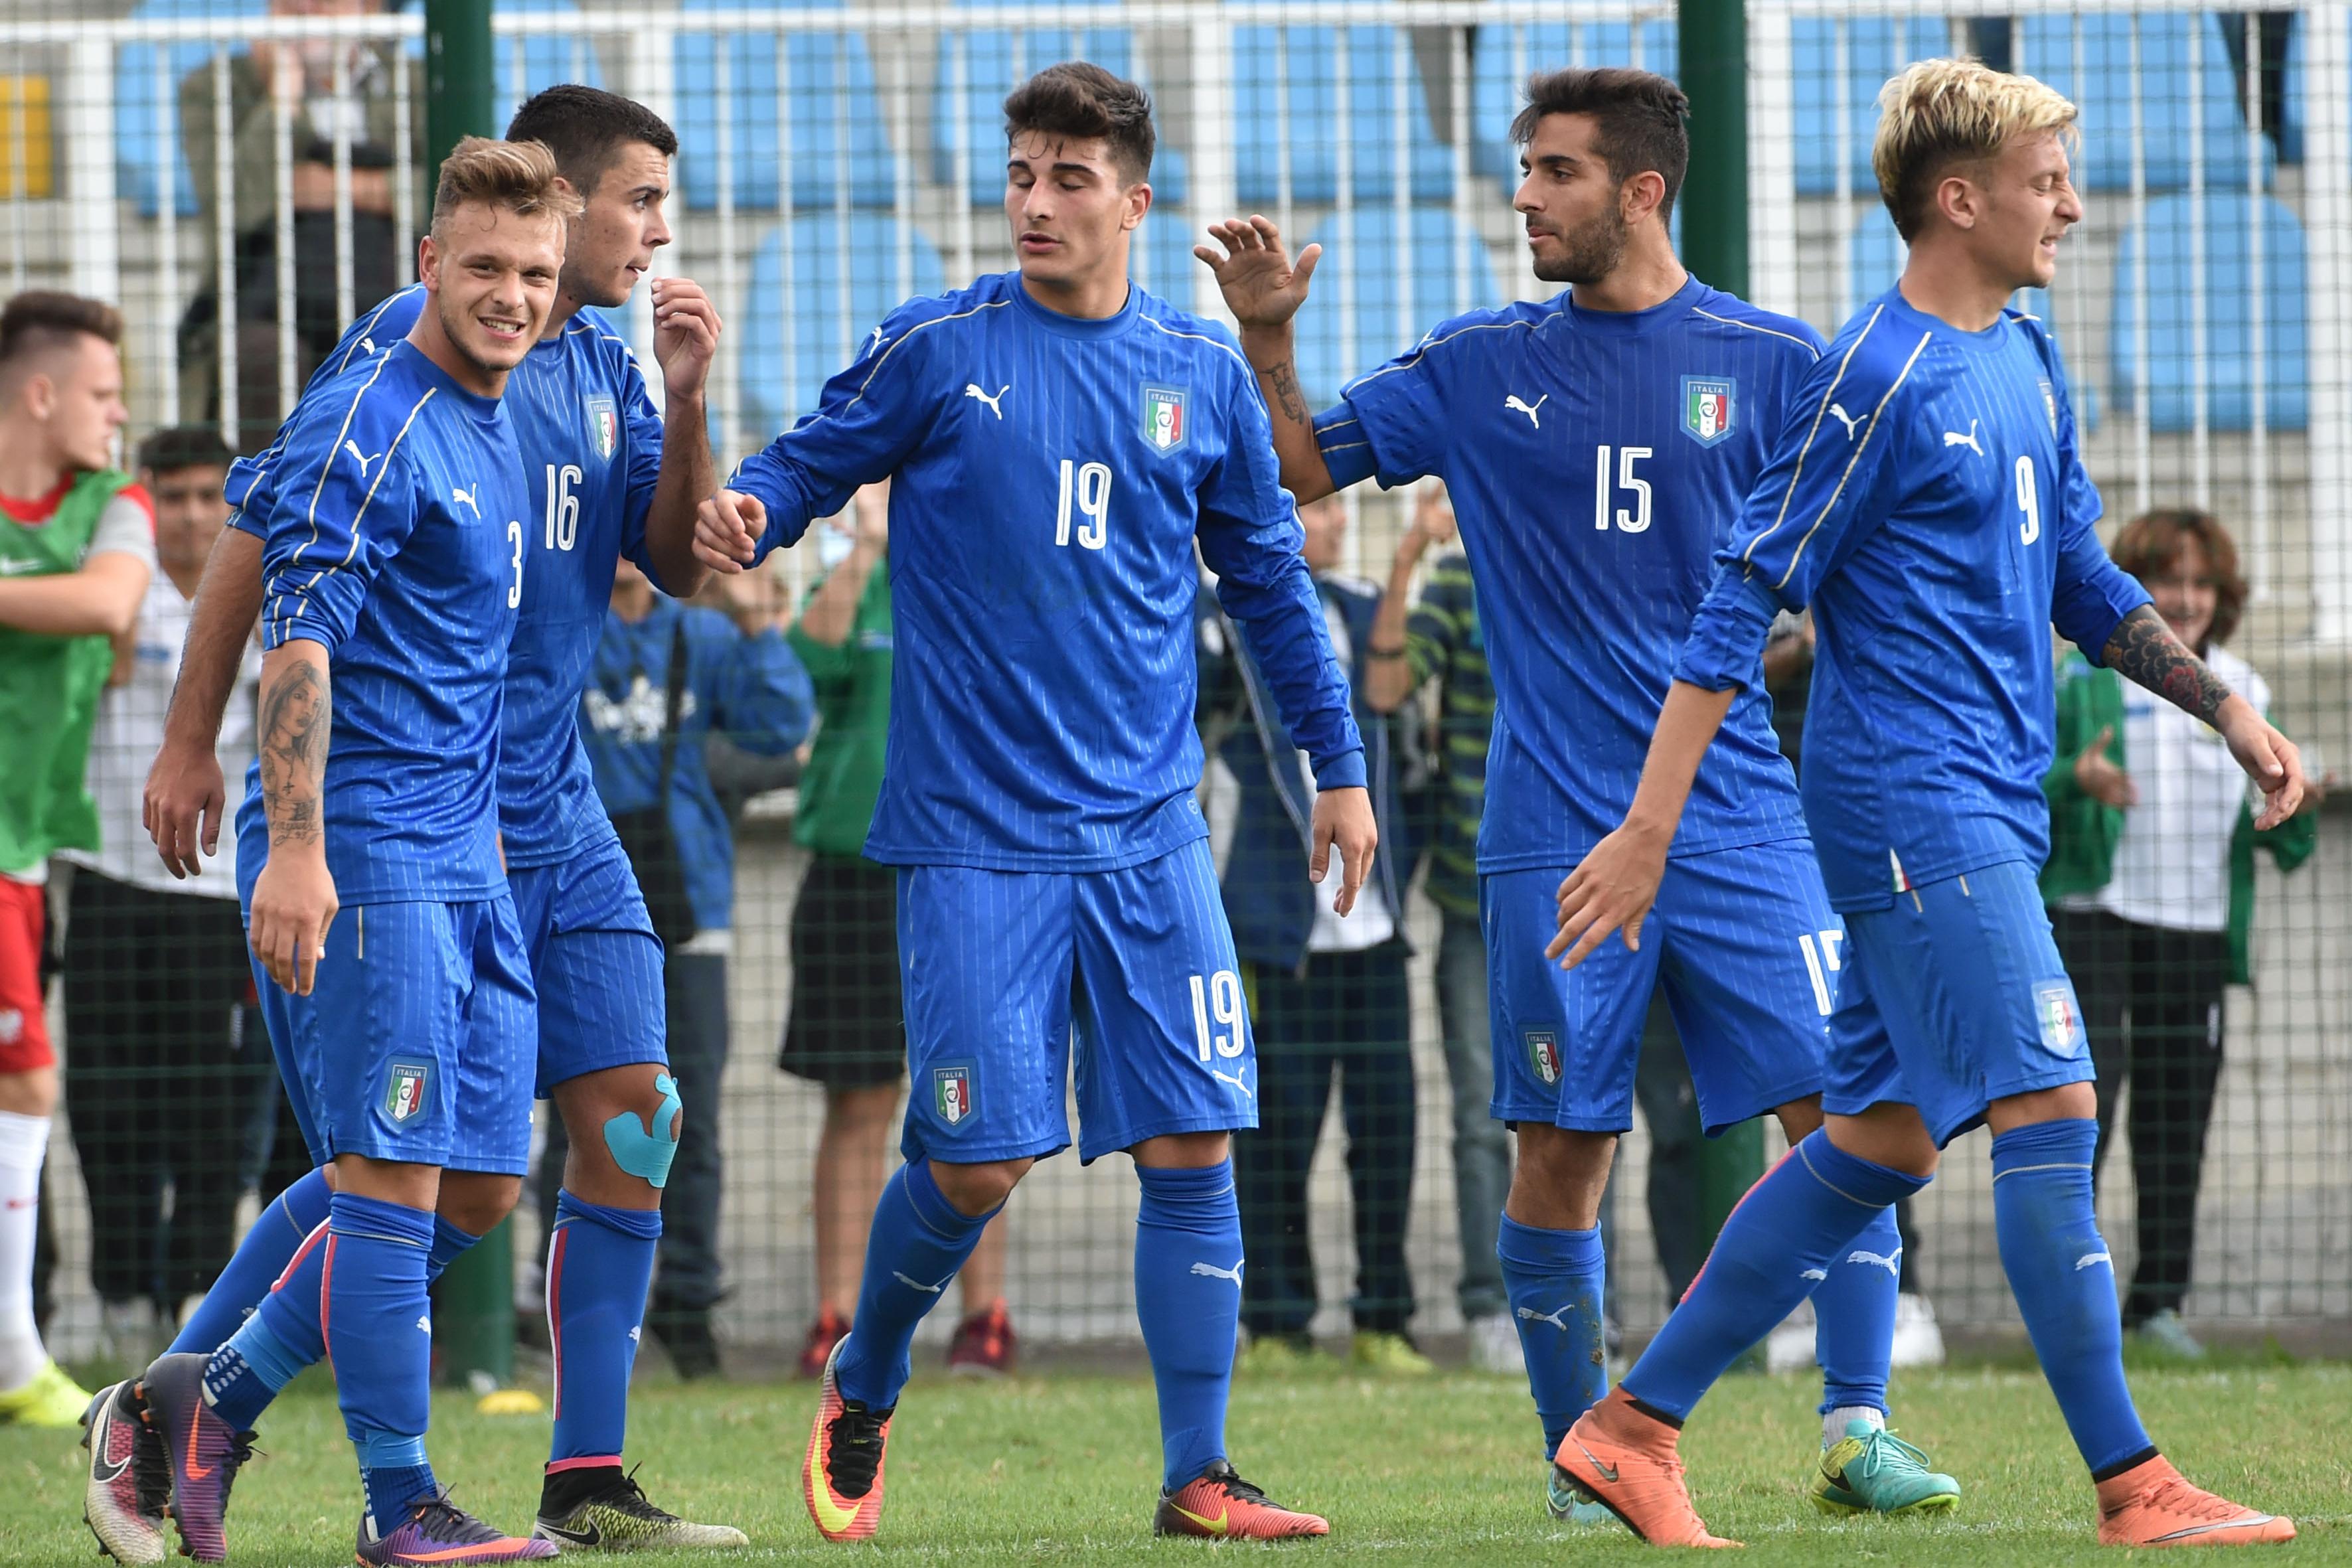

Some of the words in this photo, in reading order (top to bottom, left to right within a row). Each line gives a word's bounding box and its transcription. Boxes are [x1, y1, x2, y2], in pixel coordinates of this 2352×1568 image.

[1151, 393, 1179, 404] ITALIA
[1693, 385, 1723, 394] ITALIA
[546, 464, 582, 551] 16
[1055, 459, 1113, 550] 19
[1595, 445, 1652, 533] 15
[2015, 455, 2040, 546] 9
[508, 520, 522, 609] 3
[1189, 969, 1245, 1062] 19
[396, 1068, 422, 1077] ITALIA
[938, 1071, 963, 1079] ITALIA
